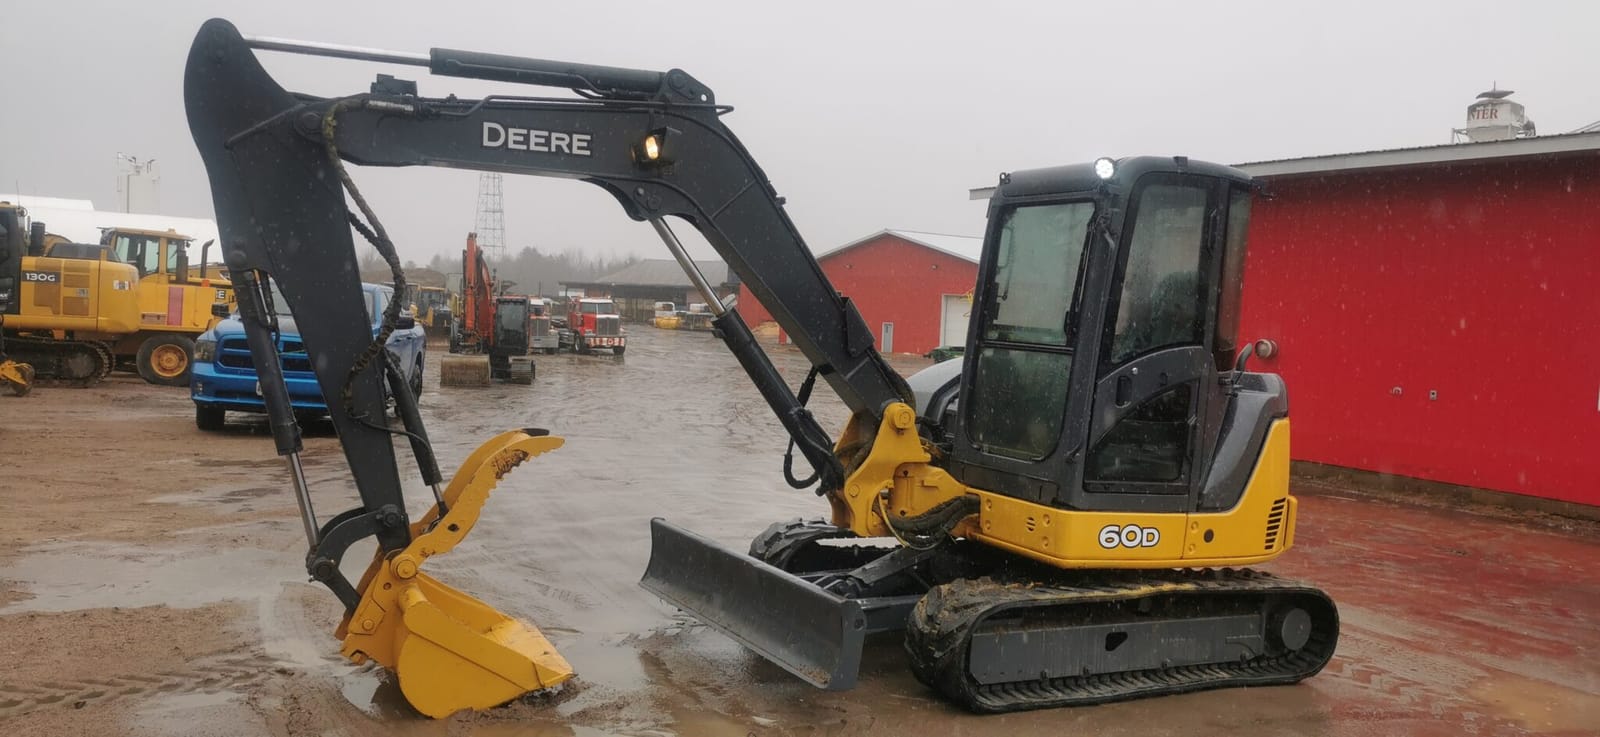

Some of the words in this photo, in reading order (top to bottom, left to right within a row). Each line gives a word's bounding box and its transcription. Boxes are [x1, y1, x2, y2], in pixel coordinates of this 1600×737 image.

[482, 121, 592, 155] DEERE
[25, 273, 56, 282] 130G
[1098, 524, 1160, 549] 60D
